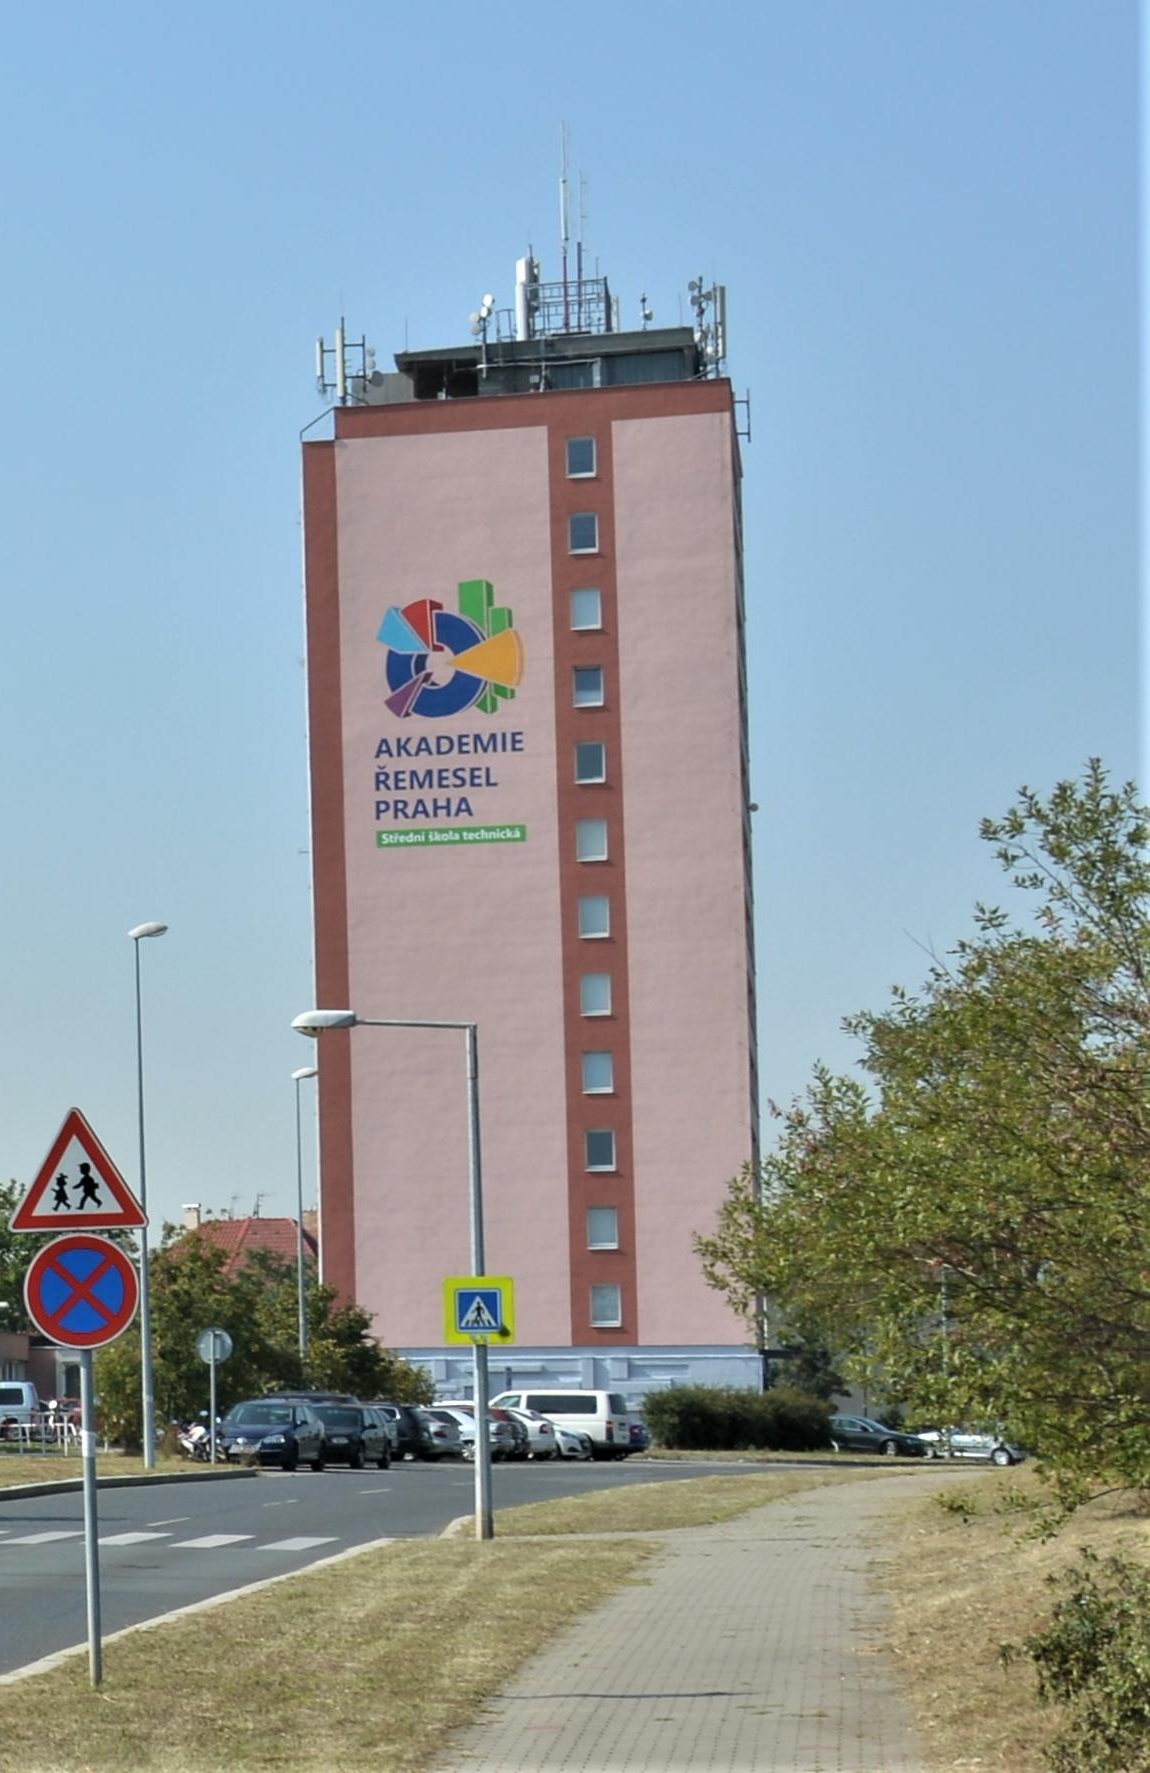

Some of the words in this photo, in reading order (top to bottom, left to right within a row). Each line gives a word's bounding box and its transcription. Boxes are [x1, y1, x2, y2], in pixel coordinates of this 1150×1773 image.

[375, 731, 524, 758] AKADEMIE
[375, 765, 498, 791] ŘEMESEL
[375, 797, 473, 820] PRAHA
[381, 831, 425, 845] Střední
[428, 830, 460, 843] škola
[463, 828, 521, 841] technická
